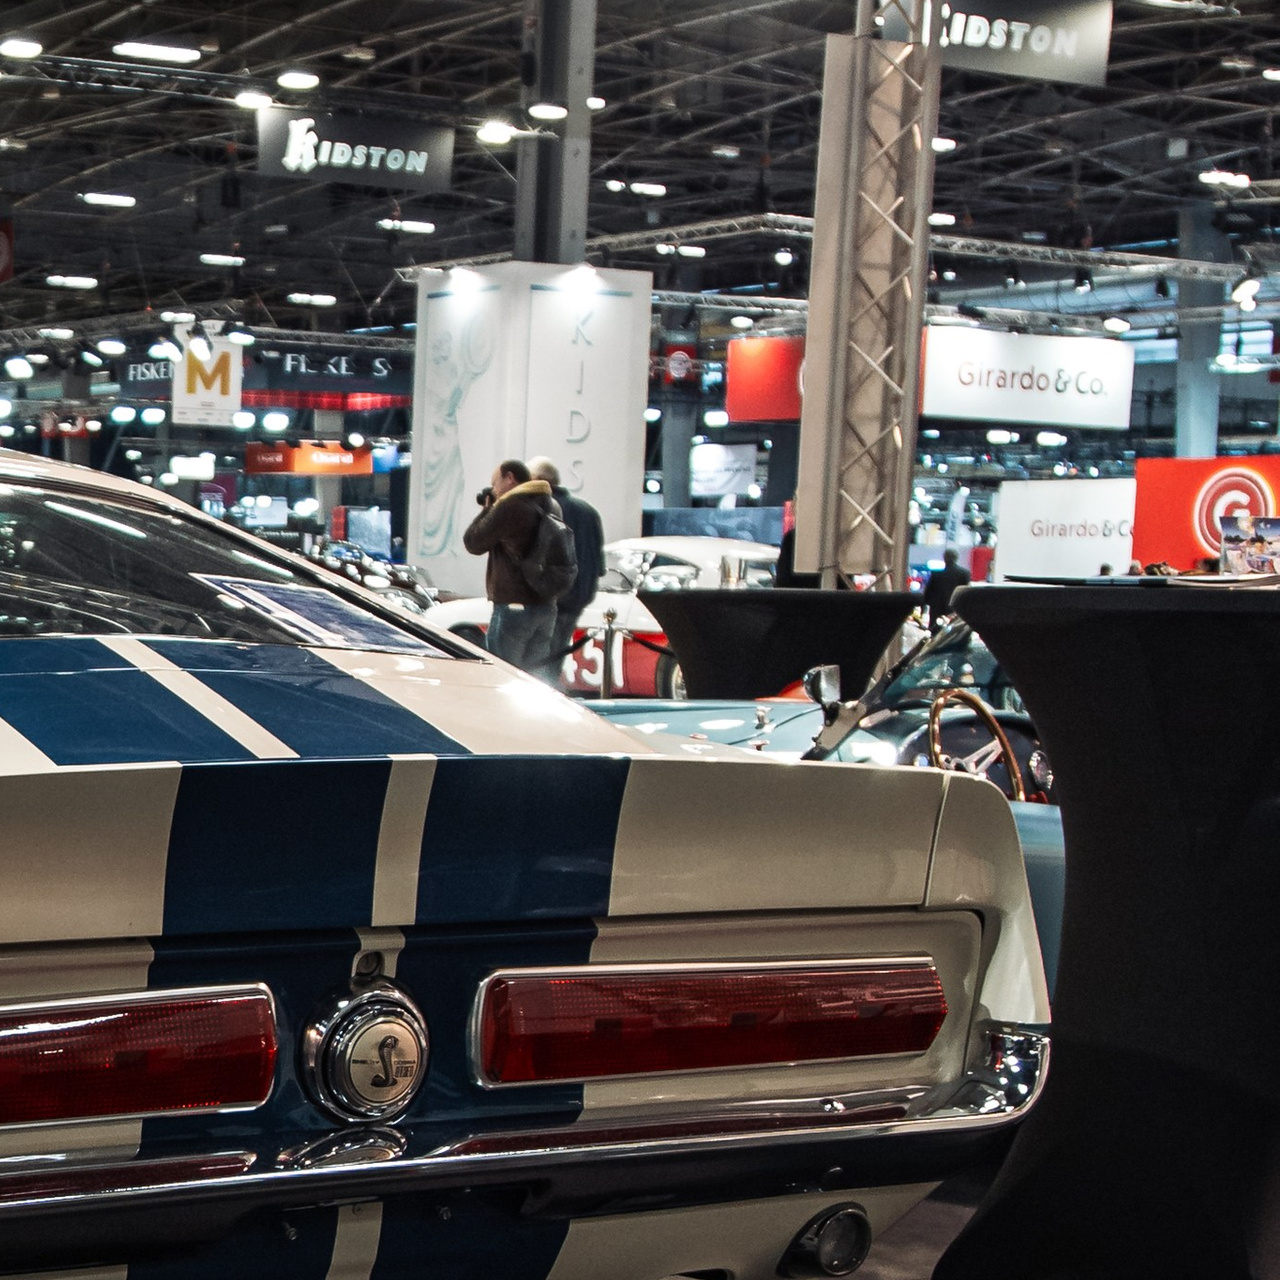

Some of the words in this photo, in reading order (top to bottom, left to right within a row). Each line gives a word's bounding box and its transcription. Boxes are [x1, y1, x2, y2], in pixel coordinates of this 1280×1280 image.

[282, 117, 429, 174] KIDSTON
[958, 362, 1051, 393] Girardo
[1053, 368, 1072, 394] &
[1075, 371, 1108, 397] Co.
[1030, 519, 1098, 538] Girardo
[1102, 520, 1116, 538] &
